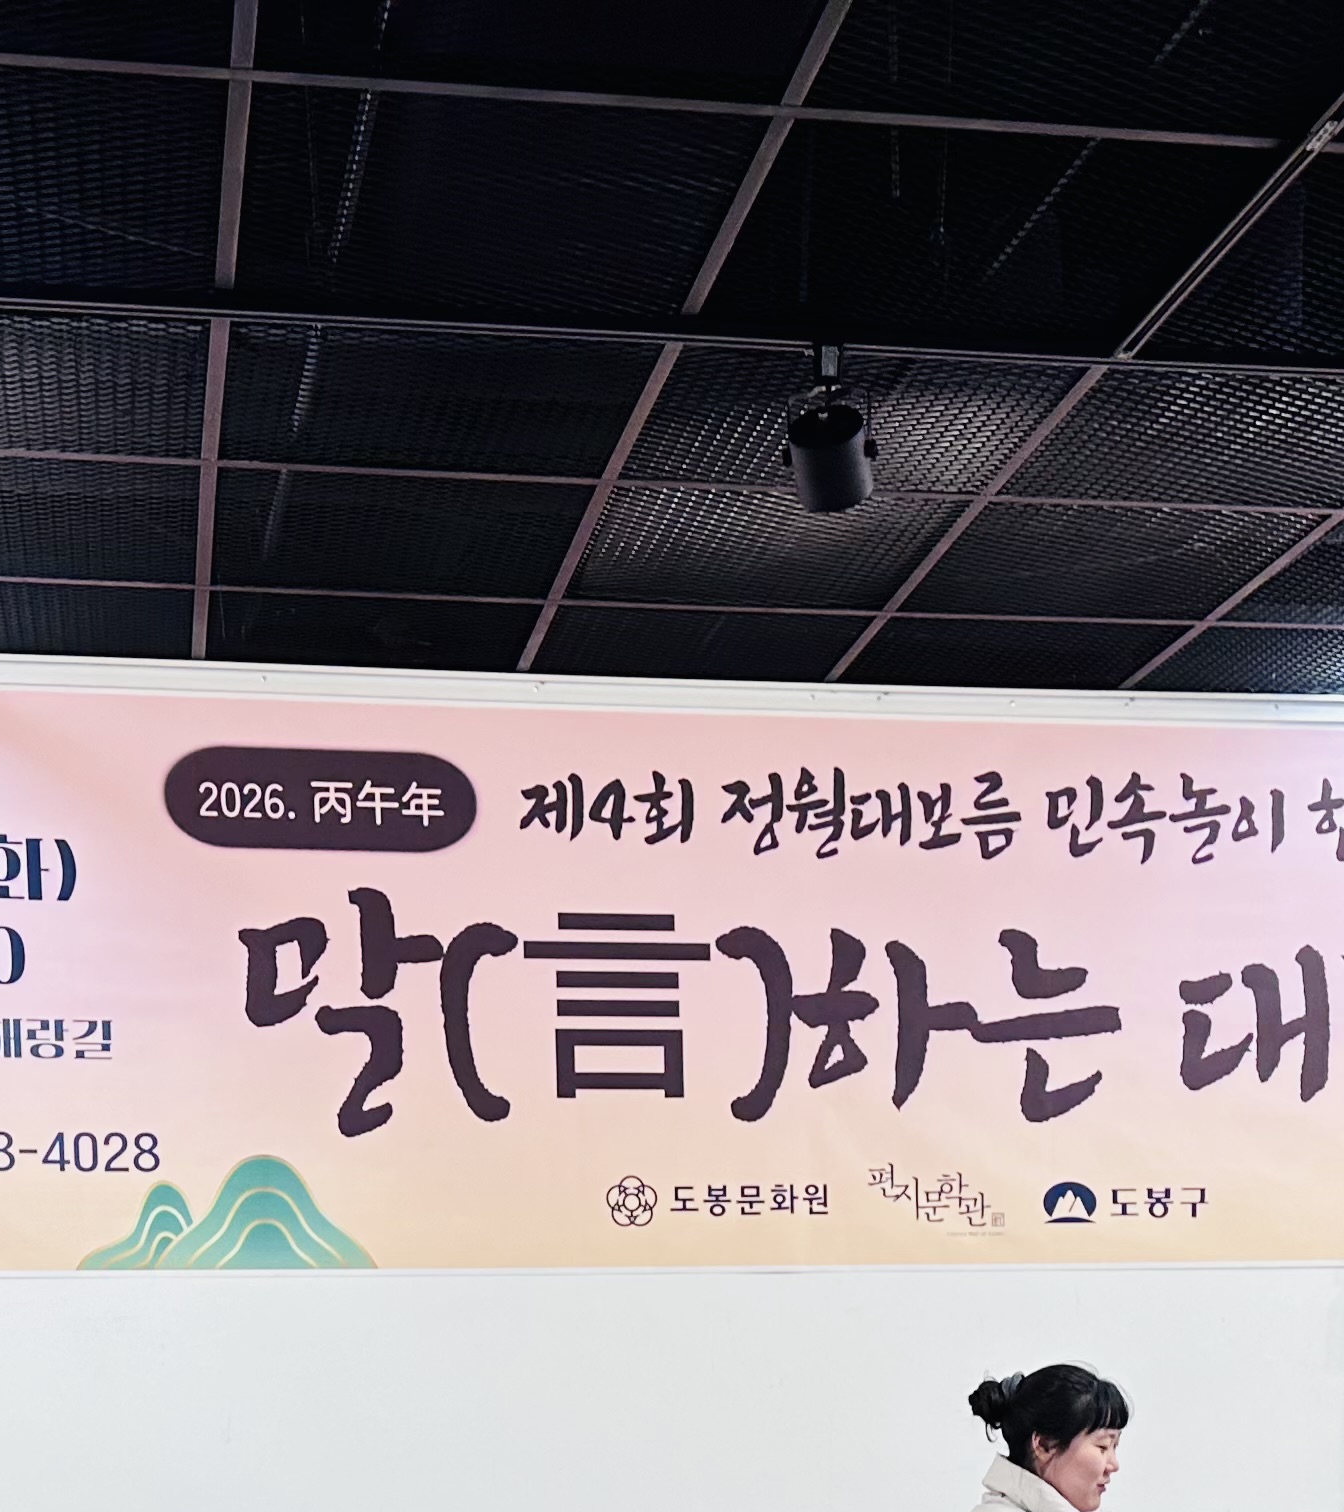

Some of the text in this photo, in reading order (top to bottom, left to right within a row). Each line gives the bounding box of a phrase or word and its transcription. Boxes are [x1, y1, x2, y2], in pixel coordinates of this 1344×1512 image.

[199, 780, 444, 826] 2026. 丙午年
[520, 771, 694, 845] 제4회
[721, 767, 1021, 860] 정월대보름
[1045, 772, 1284, 864] 민속놀이
[670, 1184, 828, 1216] 도봉문화원
[868, 1162, 992, 1227] 편지문학관
[1112, 1188, 1207, 1218] 도봉구
